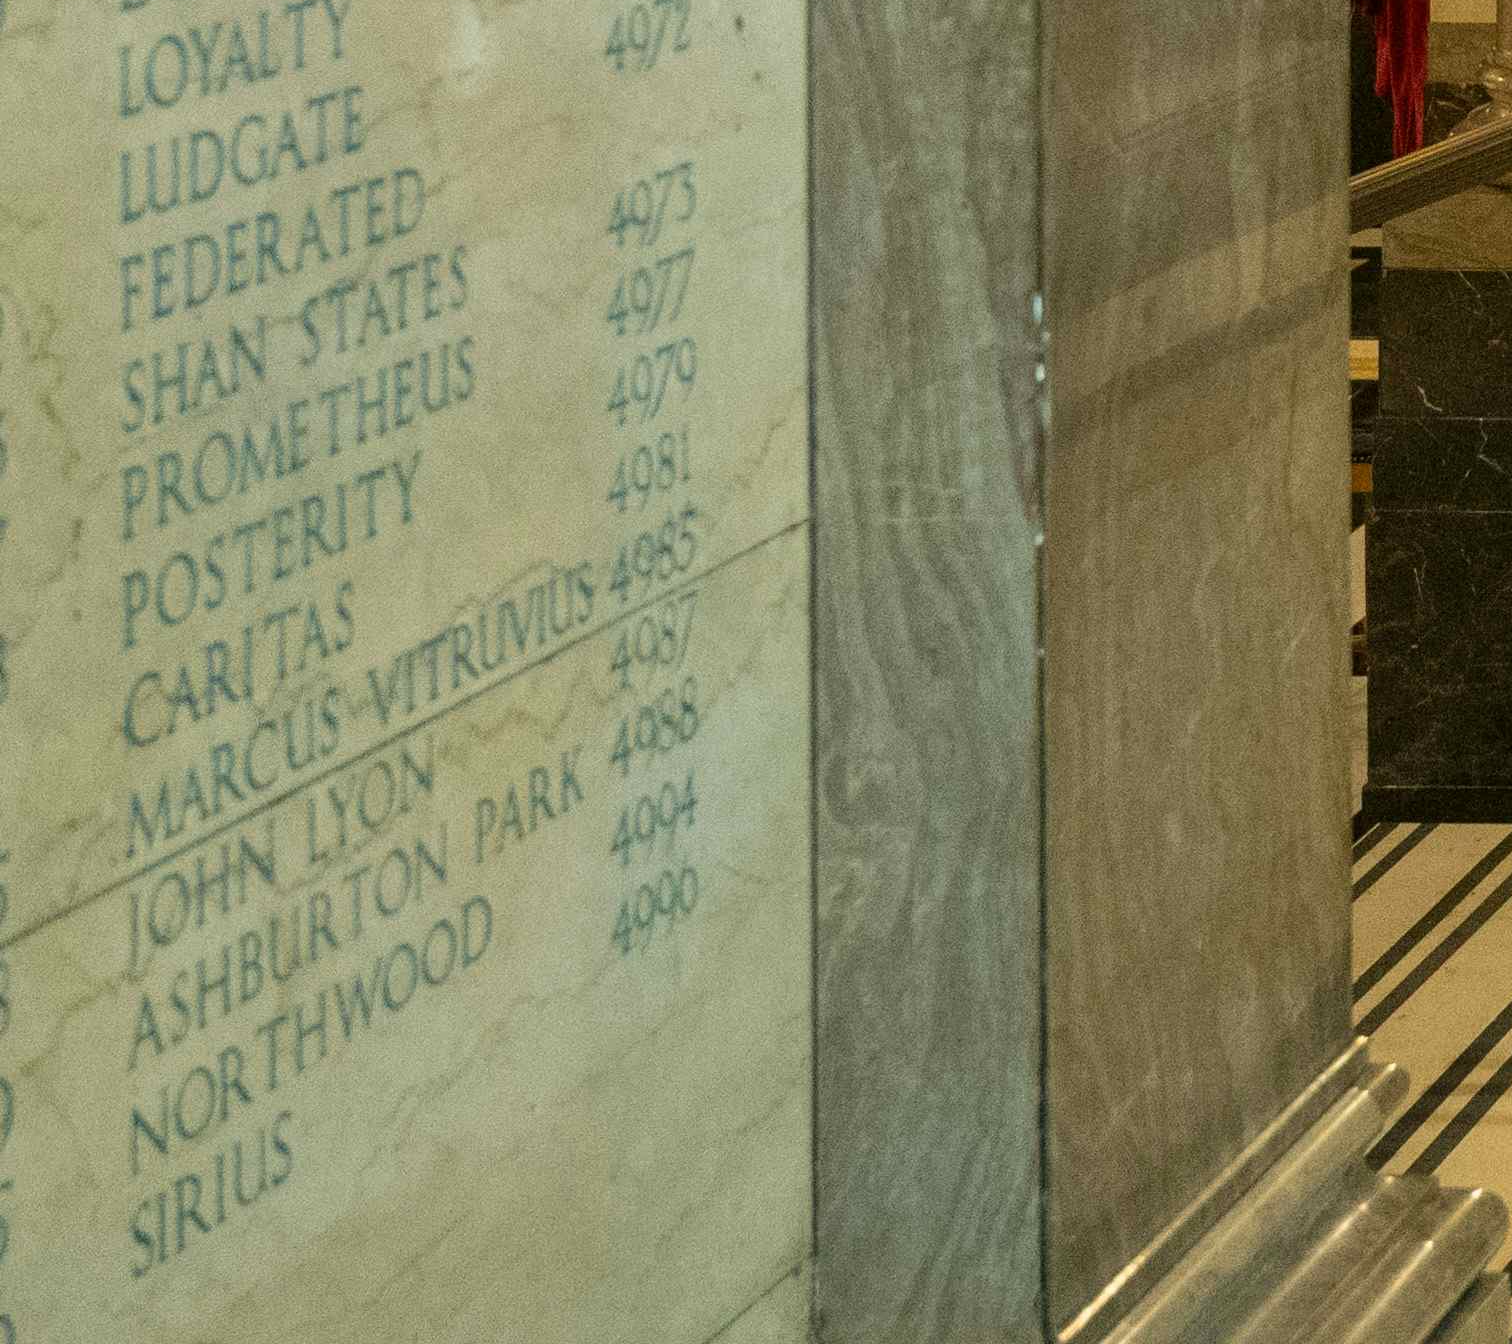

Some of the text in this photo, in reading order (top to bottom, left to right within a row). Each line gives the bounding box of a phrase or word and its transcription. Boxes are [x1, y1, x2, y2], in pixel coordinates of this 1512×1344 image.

[120, 85, 366, 225] LUDGATE
[120, 166, 427, 334] FEDERATED
[120, 247, 695, 545] PROMETHEUS 4977
[122, 318, 266, 435] SHAN
[301, 244, 472, 369] STATES
[122, 449, 424, 655] POSTERITY
[122, 430, 692, 750] CARITAS 4981
[126, 686, 341, 861] MARCUS
[366, 560, 594, 725] VITRUVIUS
[125, 823, 275, 985] JOHN
[307, 732, 442, 868] LYON
[130, 821, 448, 1071] ASHBURTON
[473, 745, 586, 864] PARK
[128, 895, 495, 1176] NORTHWOOD
[130, 1110, 296, 1280] SIRIUS
